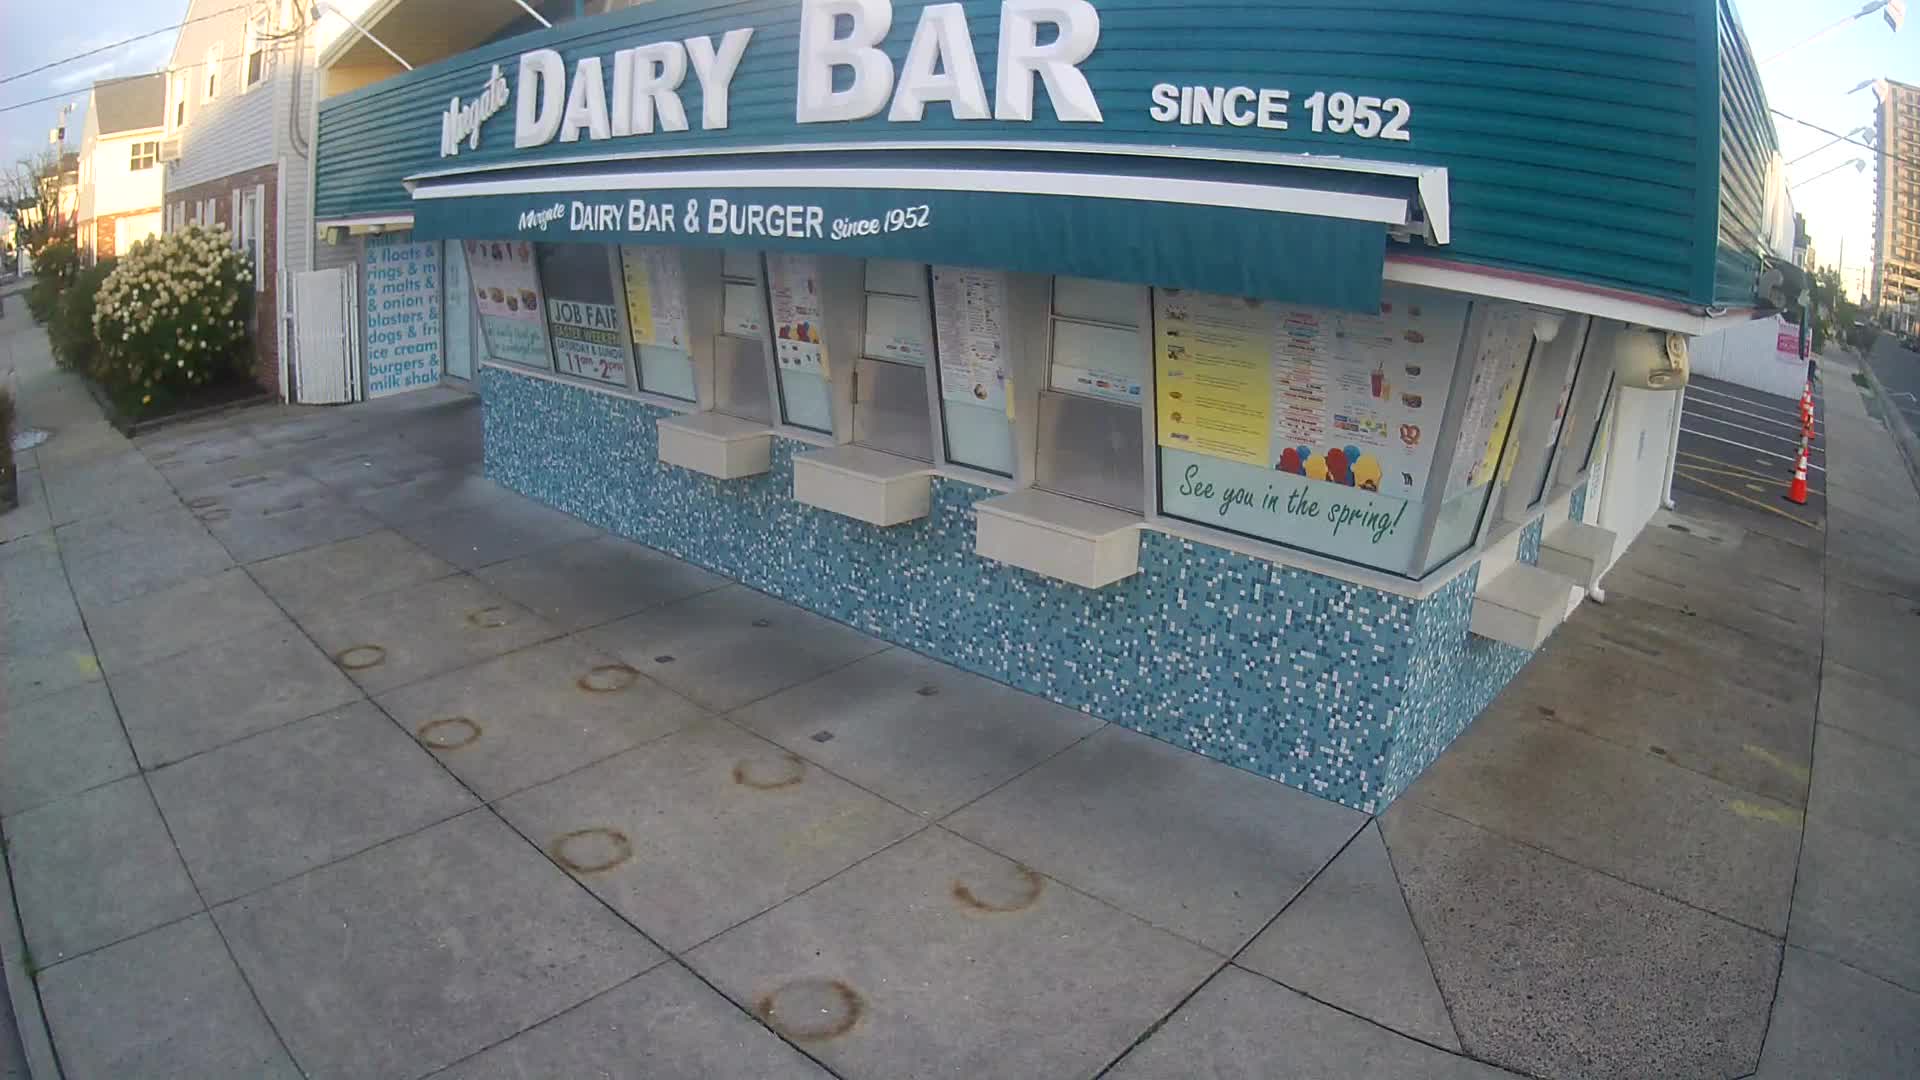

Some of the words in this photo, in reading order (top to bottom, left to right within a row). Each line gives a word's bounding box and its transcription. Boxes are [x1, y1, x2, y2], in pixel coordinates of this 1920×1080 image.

[515, 27, 753, 148] DAIRY
[796, 0, 1103, 123] BAR
[1150, 83, 1290, 129] SINCE
[1304, 91, 1410, 141] 1952
[570, 201, 624, 231] DAIRY
[628, 199, 675, 232] BAR
[684, 199, 700, 233] &
[708, 199, 823, 239] BURGER
[831, 218, 880, 240] Since
[884, 204, 929, 233] 1952
[383, 279, 421, 294] malts
[384, 295, 423, 311] onion
[554, 302, 582, 324] JOB
[368, 330, 402, 345] dogs
[408, 326, 417, 339] &
[368, 347, 388, 361] ice
[394, 341, 438, 356] cream
[369, 358, 424, 376] burgers
[430, 353, 439, 367] &
[566, 352, 593, 373] 11am
[370, 374, 400, 393] milk
[405, 369, 438, 387] shak
[1180, 464, 1215, 499] See
[1219, 488, 1254, 516] you
[1262, 485, 1277, 513] in
[1287, 486, 1320, 518] the
[1327, 499, 1408, 544] spring!
